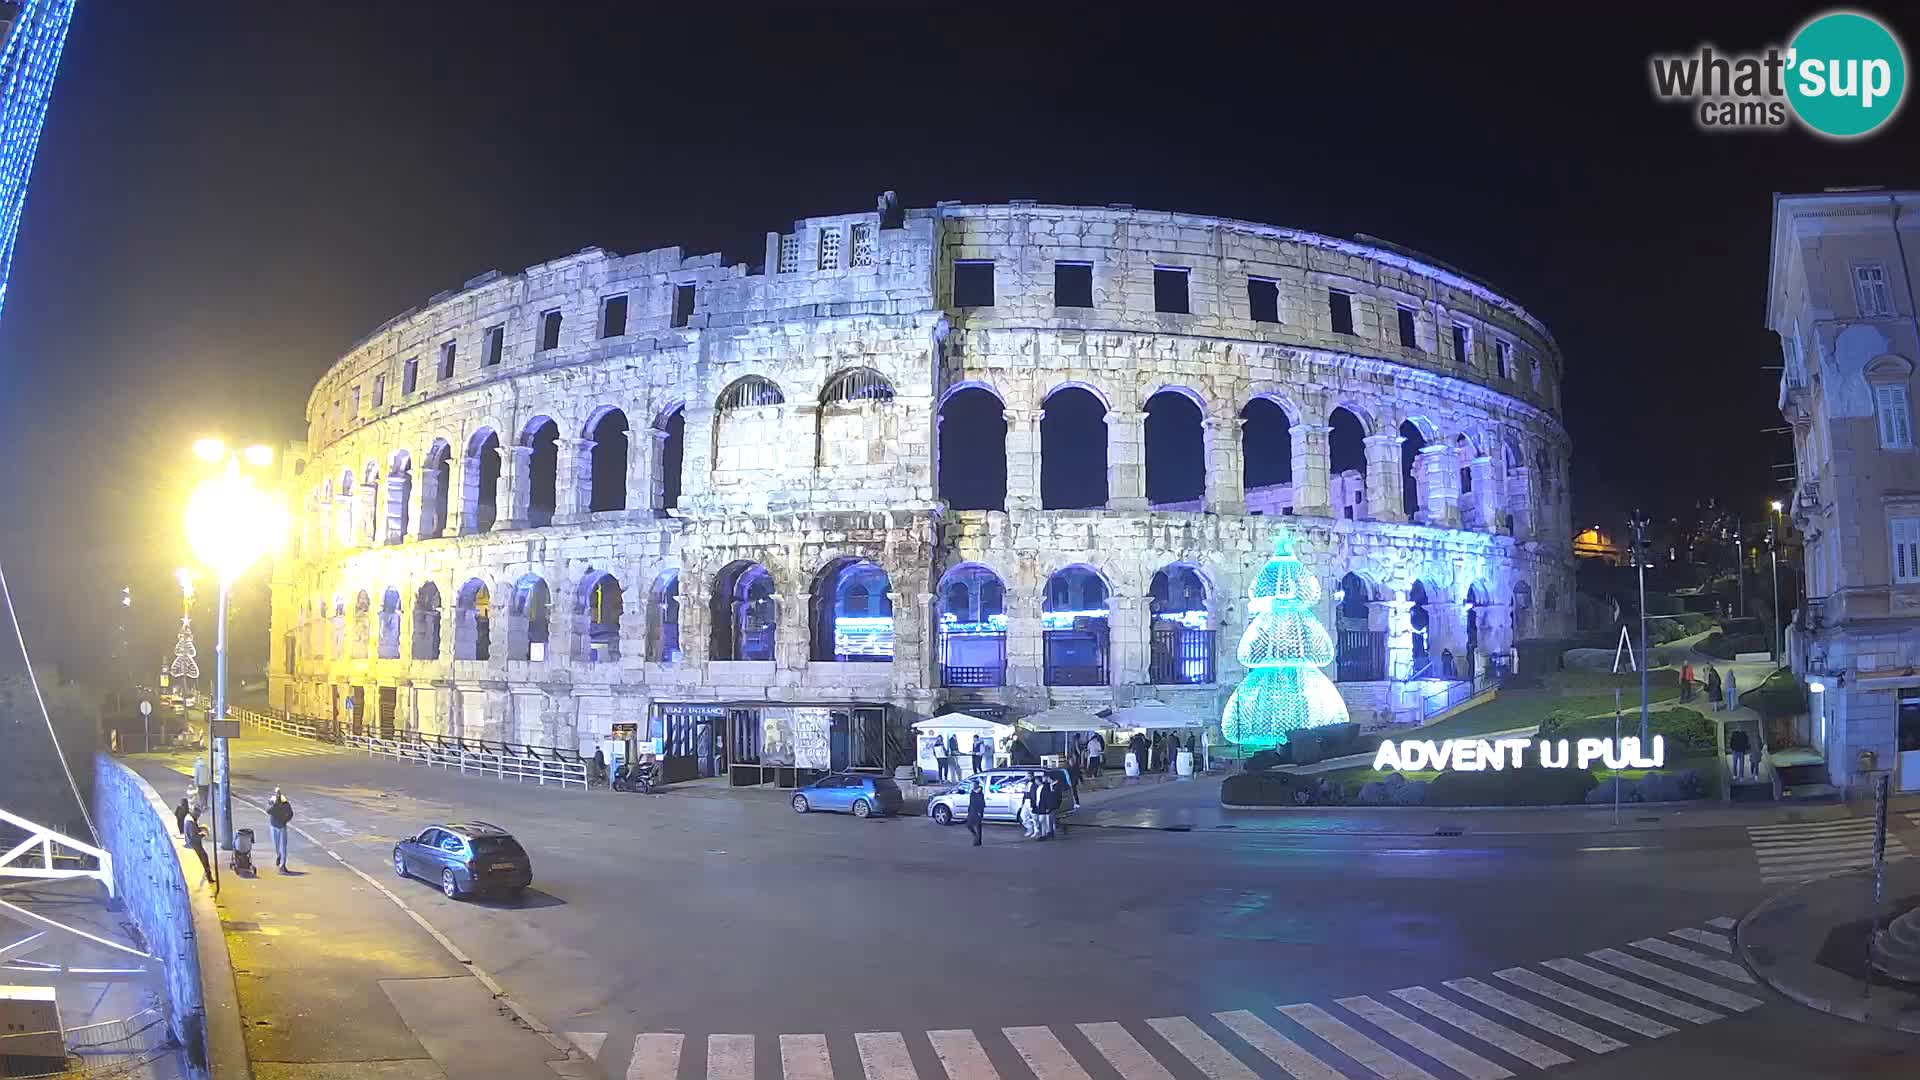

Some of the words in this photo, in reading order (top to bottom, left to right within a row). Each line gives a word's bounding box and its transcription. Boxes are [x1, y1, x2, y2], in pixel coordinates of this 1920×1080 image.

[1373, 739, 1531, 771] ADVENT
[1540, 739, 1569, 769] U
[1577, 735, 1665, 770] PULI
